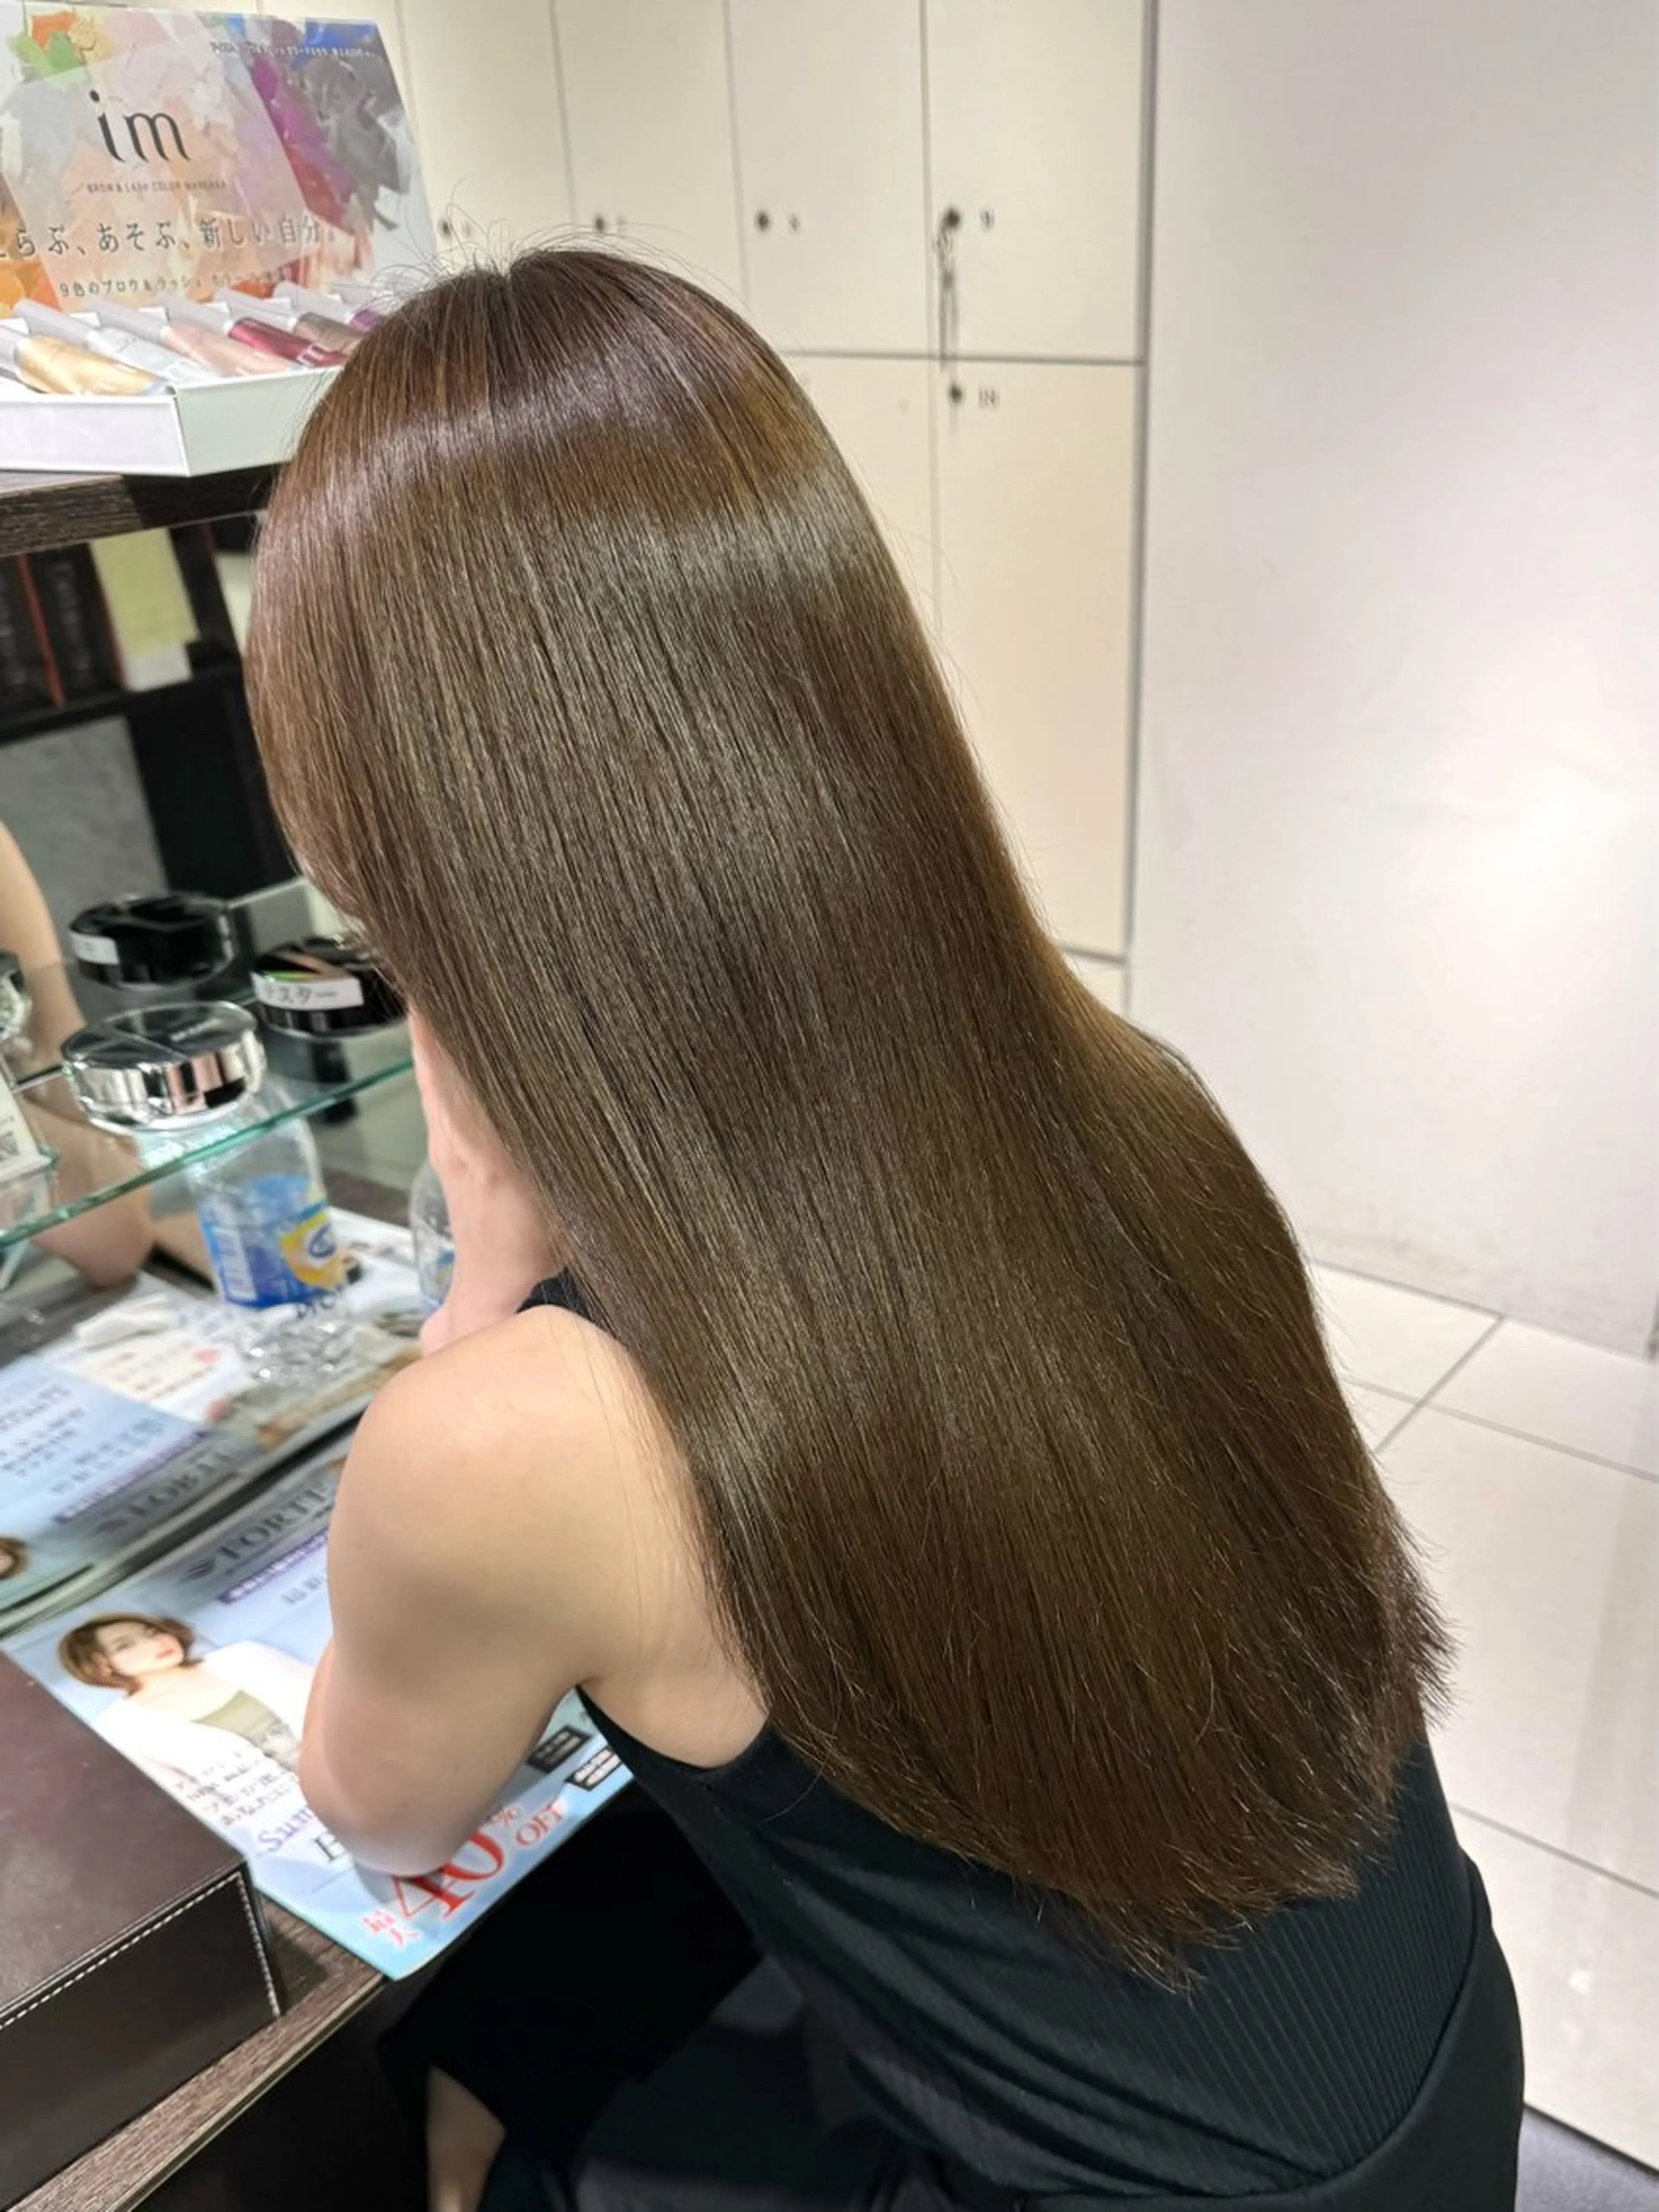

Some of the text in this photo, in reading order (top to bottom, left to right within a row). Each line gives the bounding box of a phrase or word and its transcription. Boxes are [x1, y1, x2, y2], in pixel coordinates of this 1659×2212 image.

[89, 89, 191, 163] im
[0, 214, 335, 258] らぶ、あそぶ、新しい自分。
